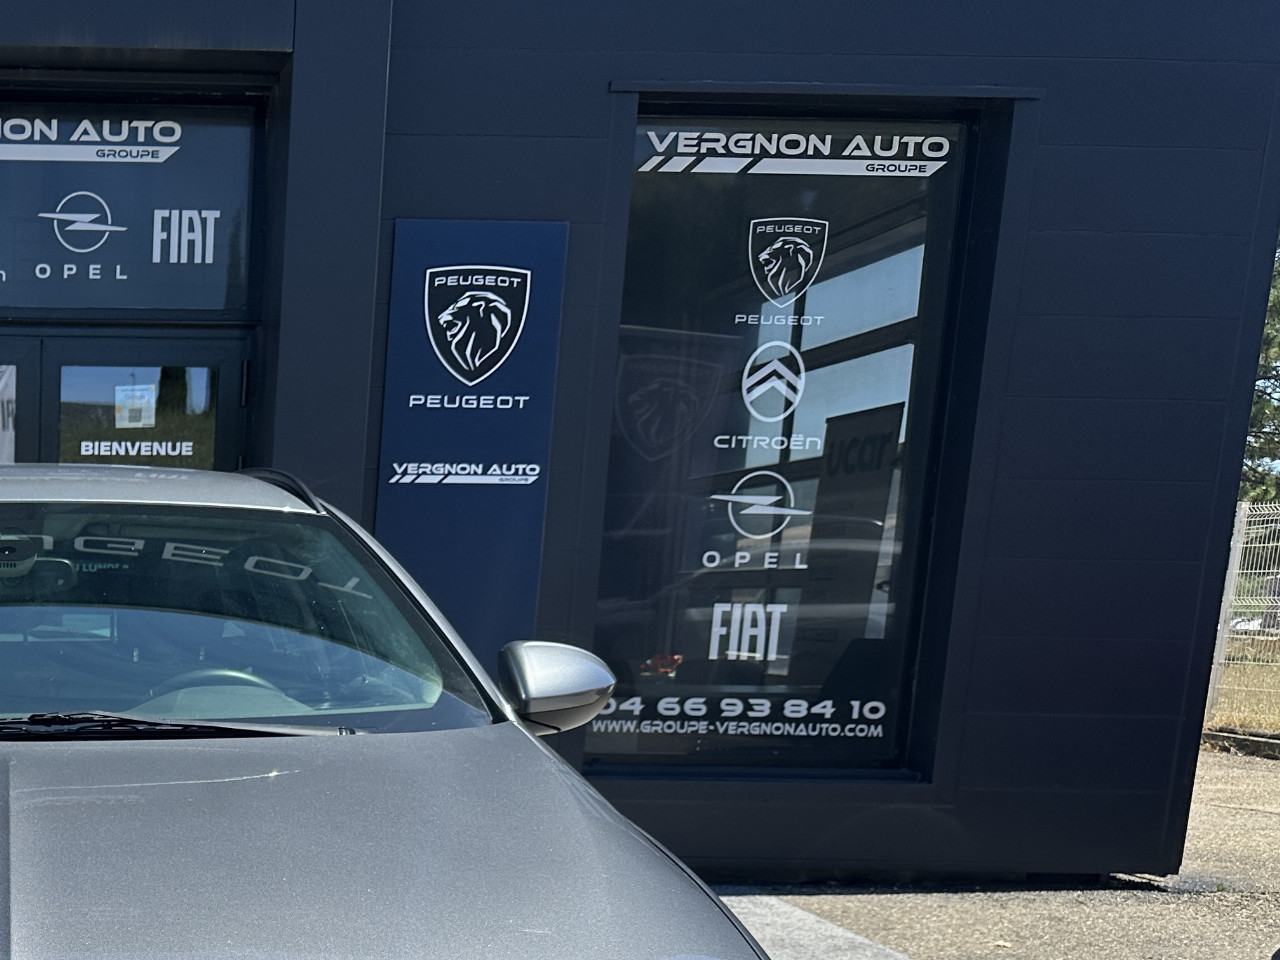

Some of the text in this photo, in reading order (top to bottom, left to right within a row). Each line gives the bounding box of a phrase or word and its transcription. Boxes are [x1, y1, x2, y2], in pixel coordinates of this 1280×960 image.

[69, 119, 182, 143] AUTO
[647, 131, 950, 158] VERGNON AUTO
[95, 148, 160, 159] GROUPE
[865, 163, 928, 173] GROUPE
[152, 209, 220, 264] FIAT
[756, 224, 822, 235] PEUGEOT
[34, 263, 128, 280] OPEL
[434, 275, 521, 288] PEUGEOT
[735, 314, 825, 326] PEUGEOT
[409, 394, 530, 409] PEUGEOT
[80, 441, 193, 456] BIENVENUE
[392, 462, 541, 475] VERGNON AUTO
[702, 550, 808, 570] OPEL
[708, 602, 788, 661] FIAT
[657, 696, 708, 717] 66
[720, 697, 771, 717] 93
[782, 699, 836, 719] 84
[849, 700, 886, 720] 10
[591, 719, 883, 738] WWW.GROUPE-VERGNONAUTO.COM
